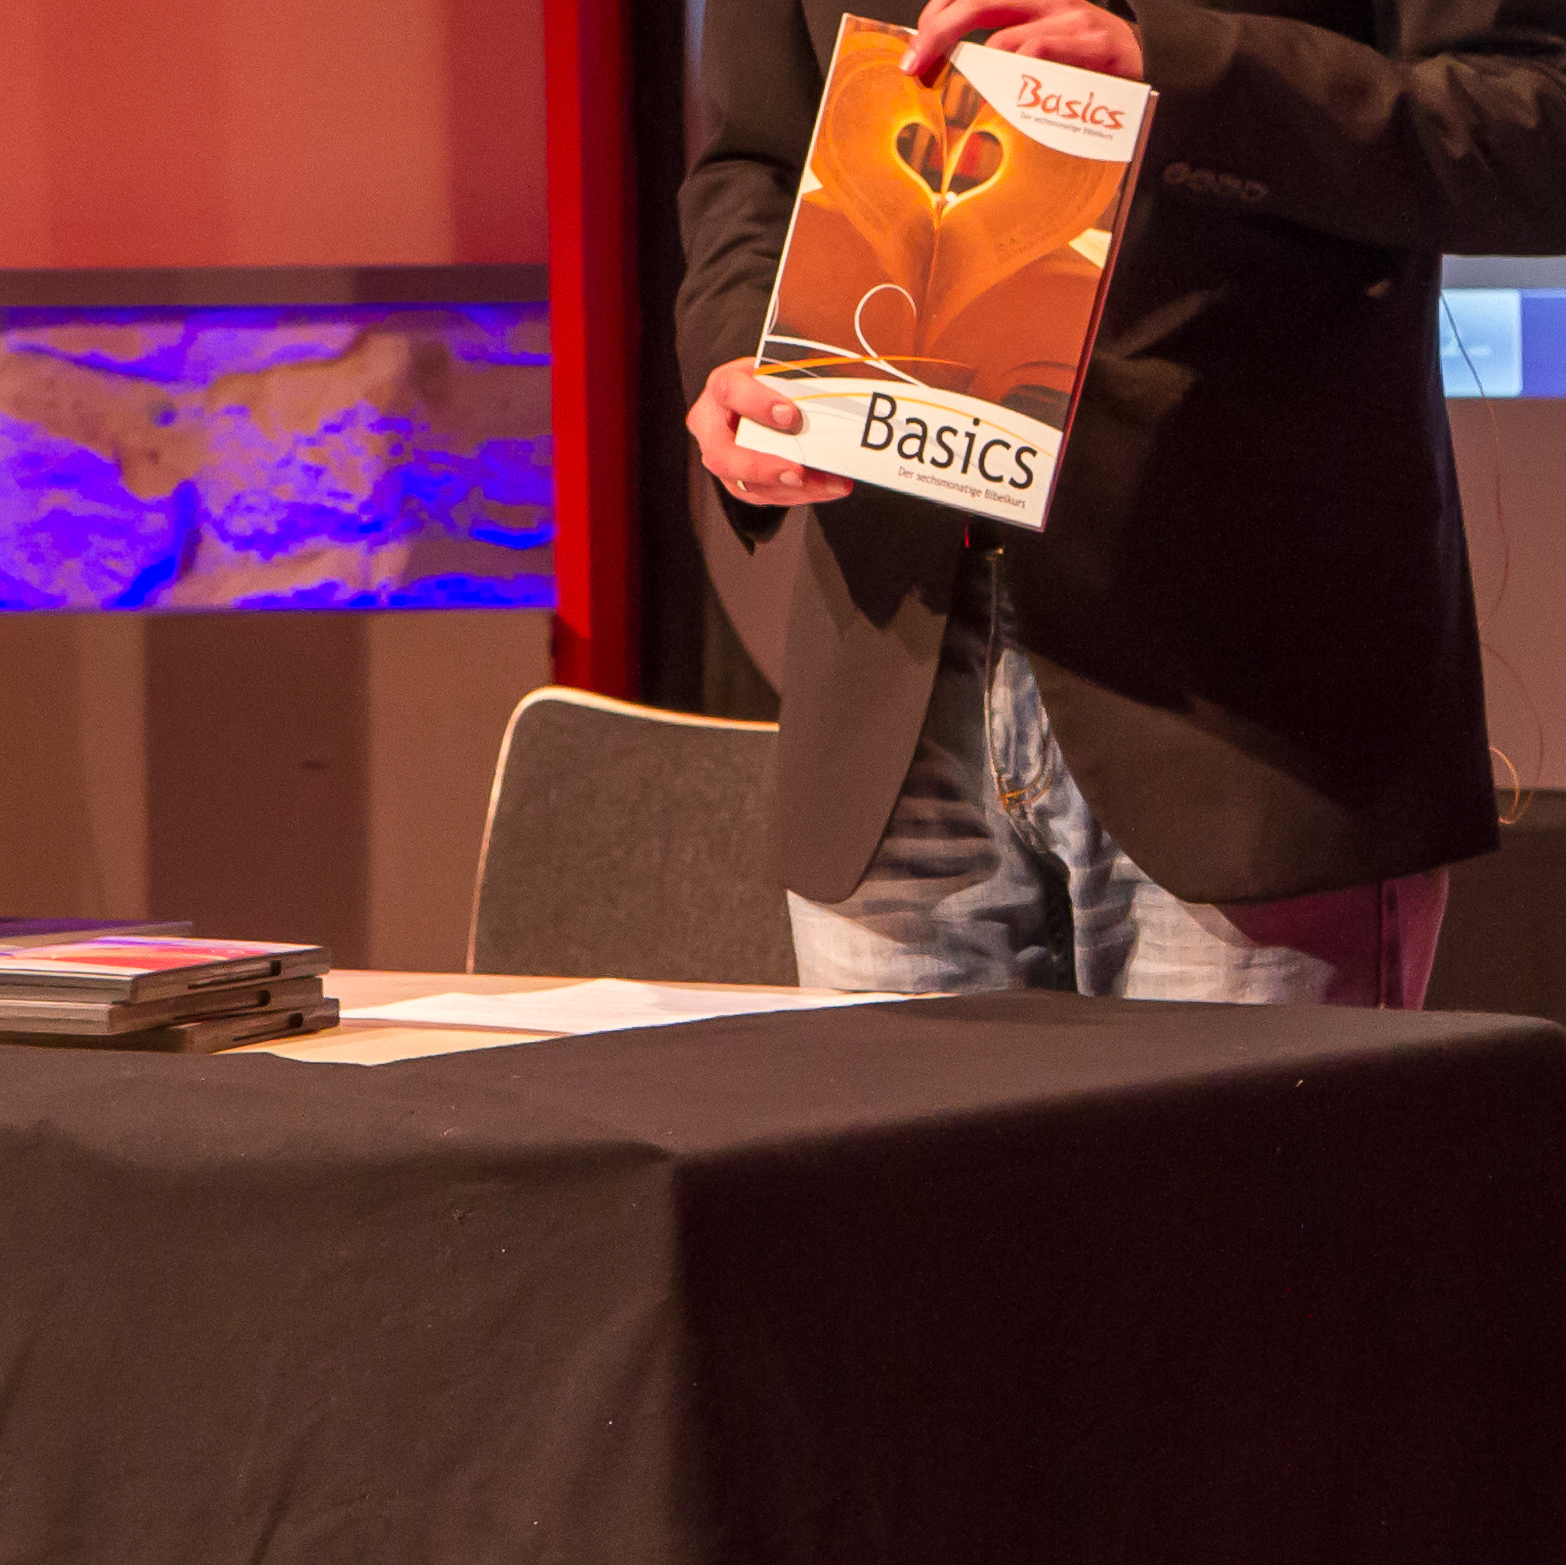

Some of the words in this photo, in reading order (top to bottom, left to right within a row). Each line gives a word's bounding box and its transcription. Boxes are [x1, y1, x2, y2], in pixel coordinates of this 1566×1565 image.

[1017, 73, 1127, 130] Basics
[860, 391, 1038, 490] Basics
[898, 465, 914, 480] Der
[915, 471, 983, 498] sechsmonatige
